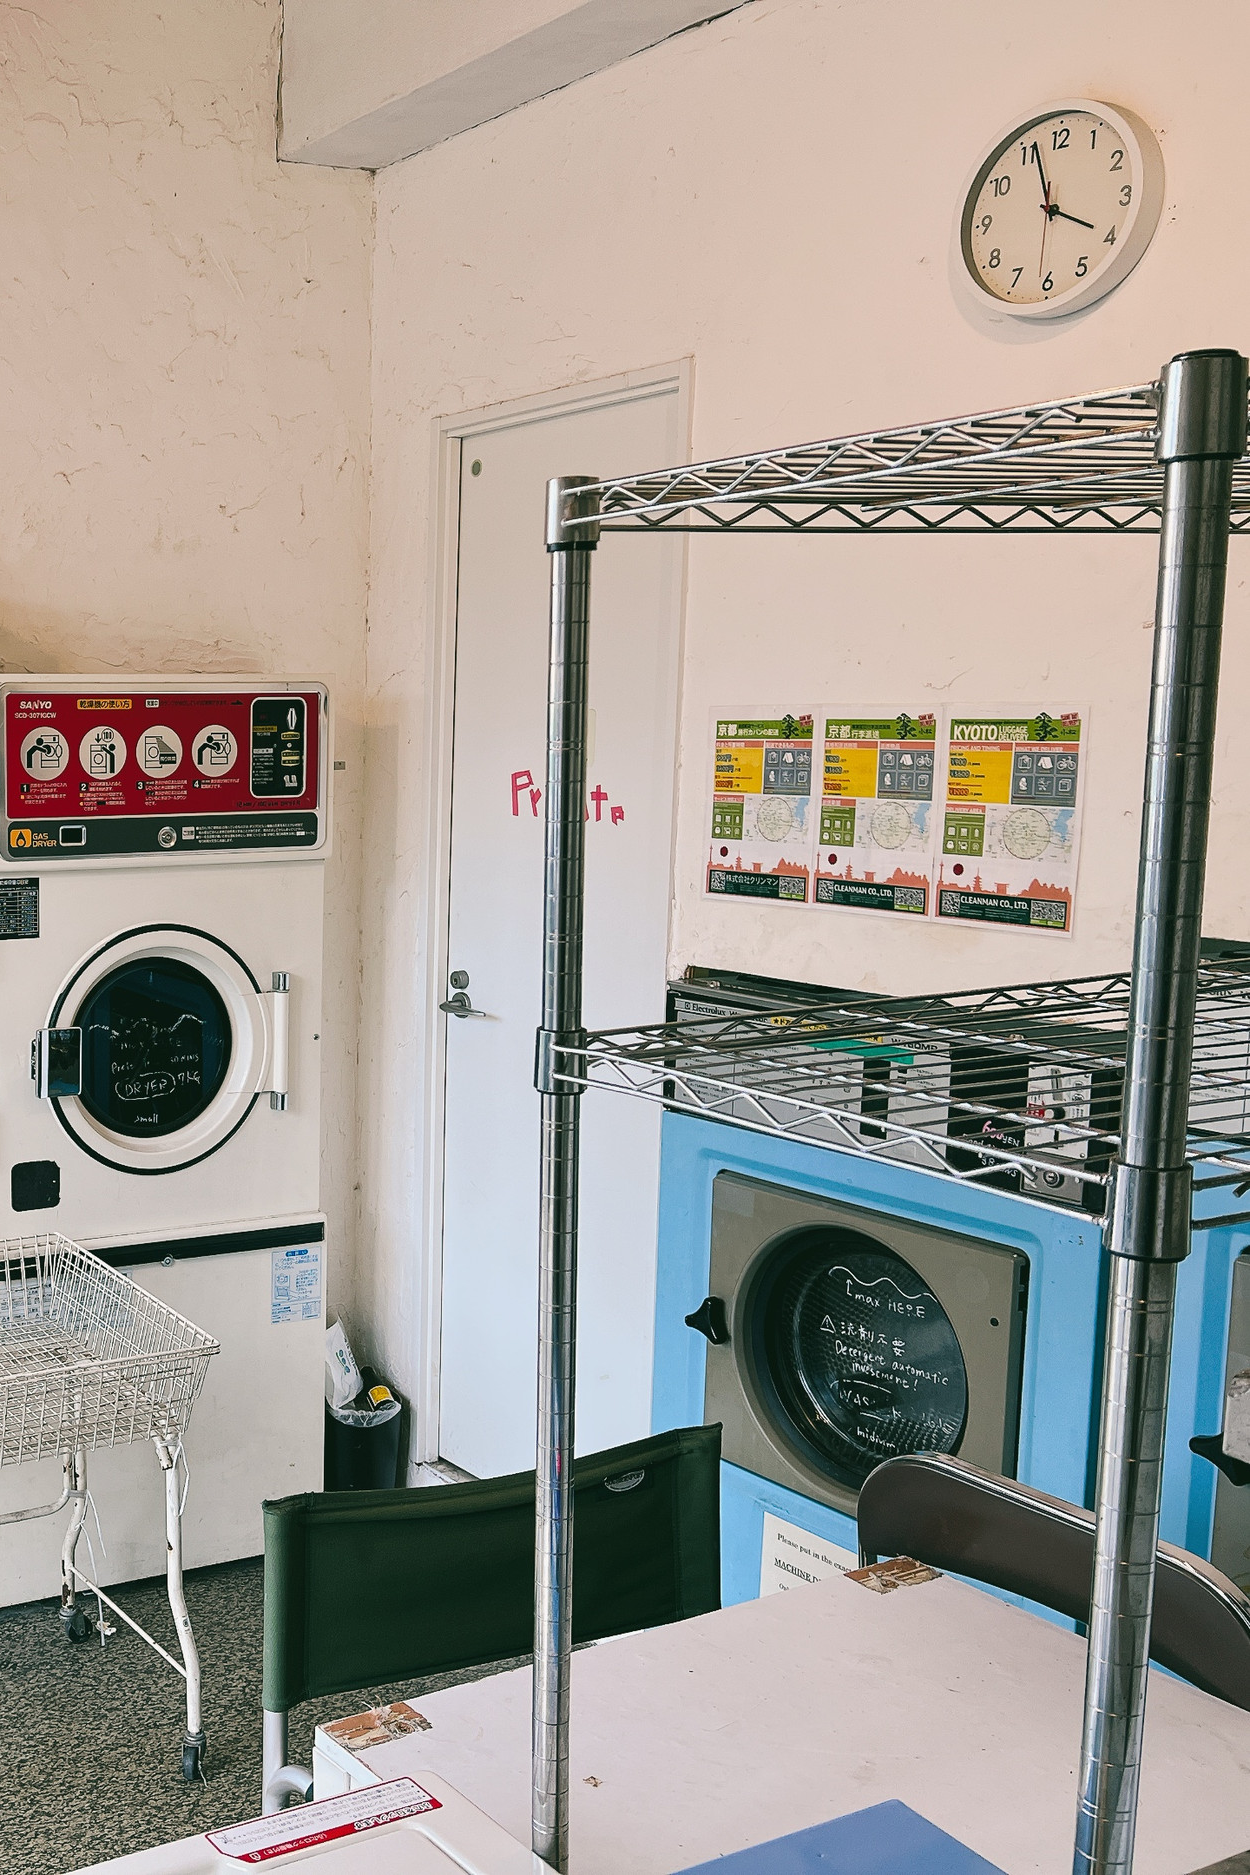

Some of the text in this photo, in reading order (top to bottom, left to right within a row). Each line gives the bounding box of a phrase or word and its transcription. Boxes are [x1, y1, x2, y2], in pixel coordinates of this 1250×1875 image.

[1052, 128, 1070, 150] 12
[1090, 129, 1097, 150] 1
[1109, 149, 1124, 171] 2
[993, 175, 1011, 198] 10
[1119, 184, 1132, 206] 3
[981, 214, 992, 235] 9
[1103, 224, 1116, 245] 4
[988, 248, 1001, 269] 8
[1075, 255, 1088, 277] 5
[1011, 267, 1024, 288] 7
[1042, 271, 1053, 291] 6
[20, 701, 52, 710] SANYO
[79, 700, 130, 709] 乾燥機の使い方
[717, 723, 738, 737] 京都
[828, 724, 851, 739] 京都
[953, 724, 998, 741] KYOTO
[998, 725, 1028, 734] LUGGAGE
[998, 733, 1029, 741] DELIVERY
[81, 783, 87, 791] 2
[137, 781, 144, 790] 3
[193, 780, 200, 789] 4
[32, 832, 49, 840] GAS
[32, 840, 57, 848] DRYER
[834, 883, 868, 895] CLEANMAN
[880, 889, 894, 898] LTD.
[960, 895, 999, 907] CLEANMAN
[1014, 901, 1030, 911] LTD.
[692, 1003, 727, 1017] Electrolux
[125, 1078, 168, 1097] DRYER
[854, 1293, 880, 1308] max
[891, 1360, 950, 1386] automatic
[777, 1532, 799, 1550] Please
[799, 1545, 812, 1556] put
[812, 1551, 820, 1560] in
[821, 1554, 833, 1566] the
[773, 1557, 813, 1584] MACHINE
